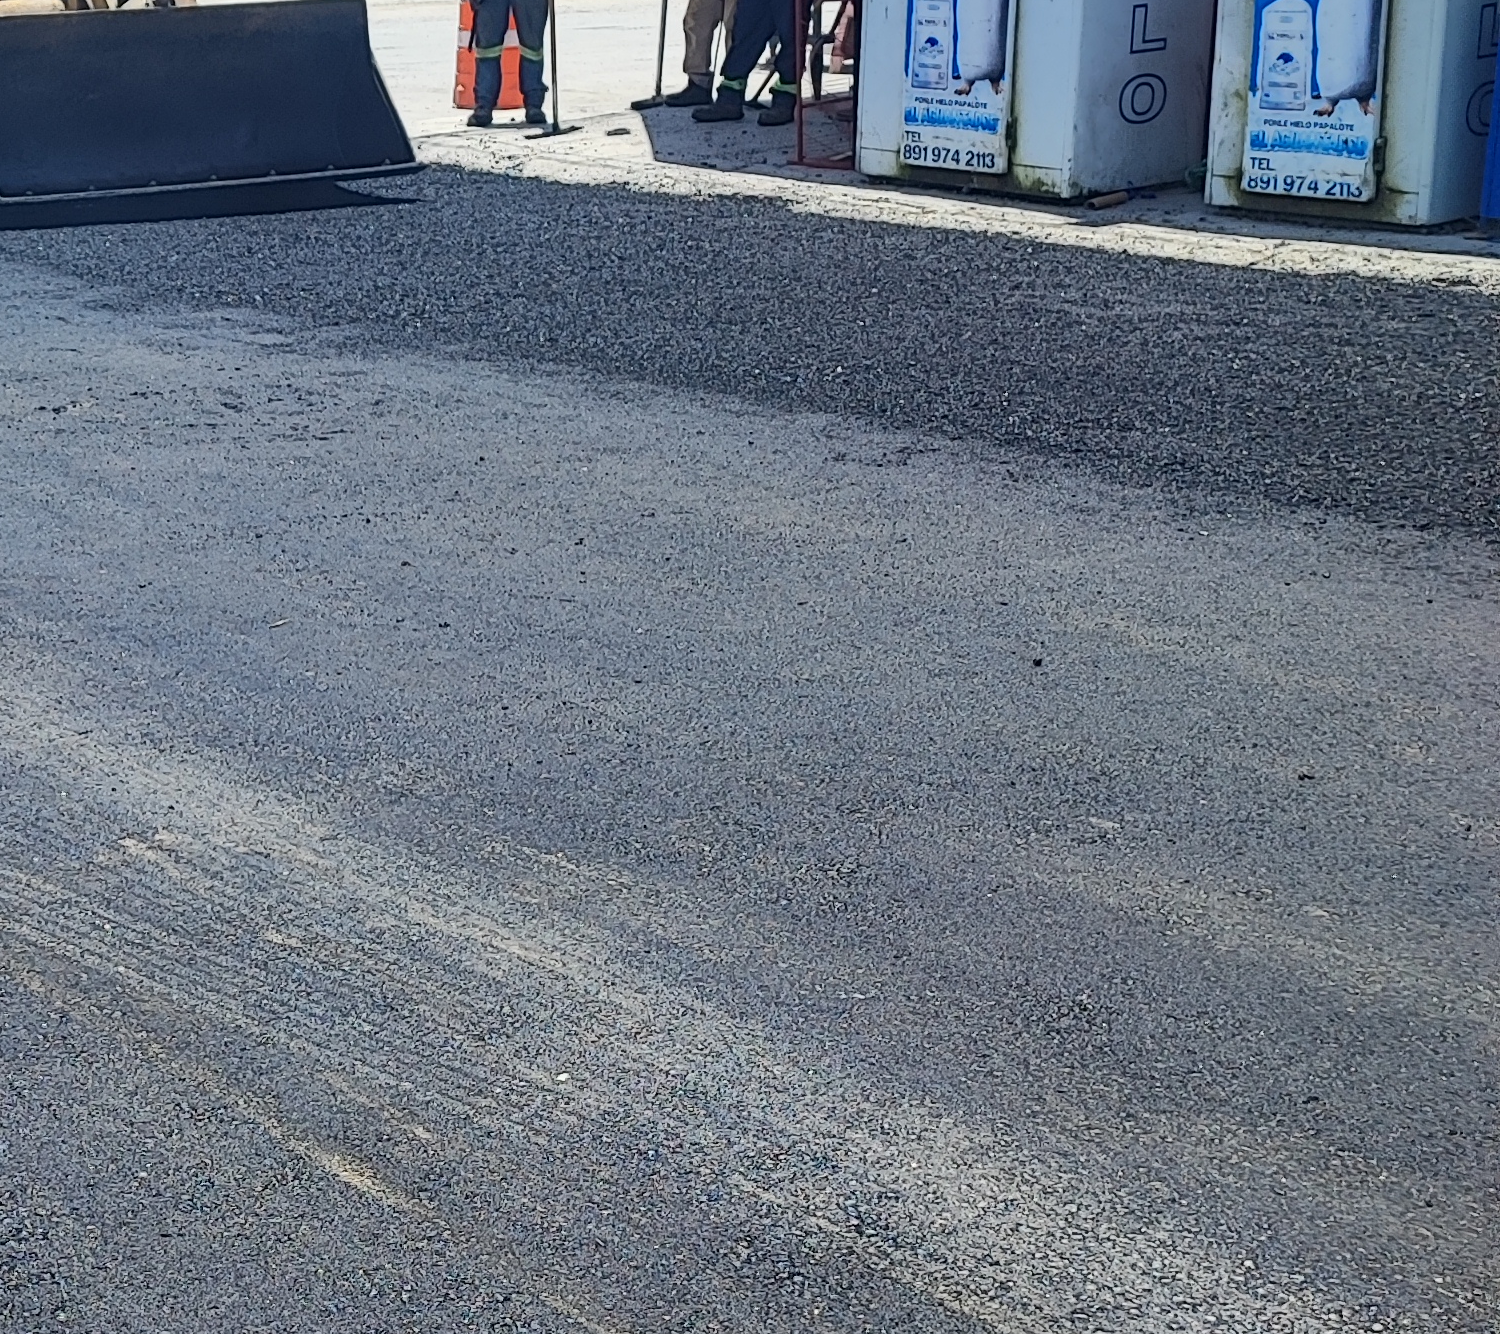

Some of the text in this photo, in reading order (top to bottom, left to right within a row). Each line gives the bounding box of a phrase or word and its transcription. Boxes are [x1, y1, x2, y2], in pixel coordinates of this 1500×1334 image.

[904, 130, 924, 143] TEL
[903, 144, 995, 169] 891 974 2113
[1250, 157, 1276, 171] TEL
[1247, 174, 1363, 198] 891 974 2113
